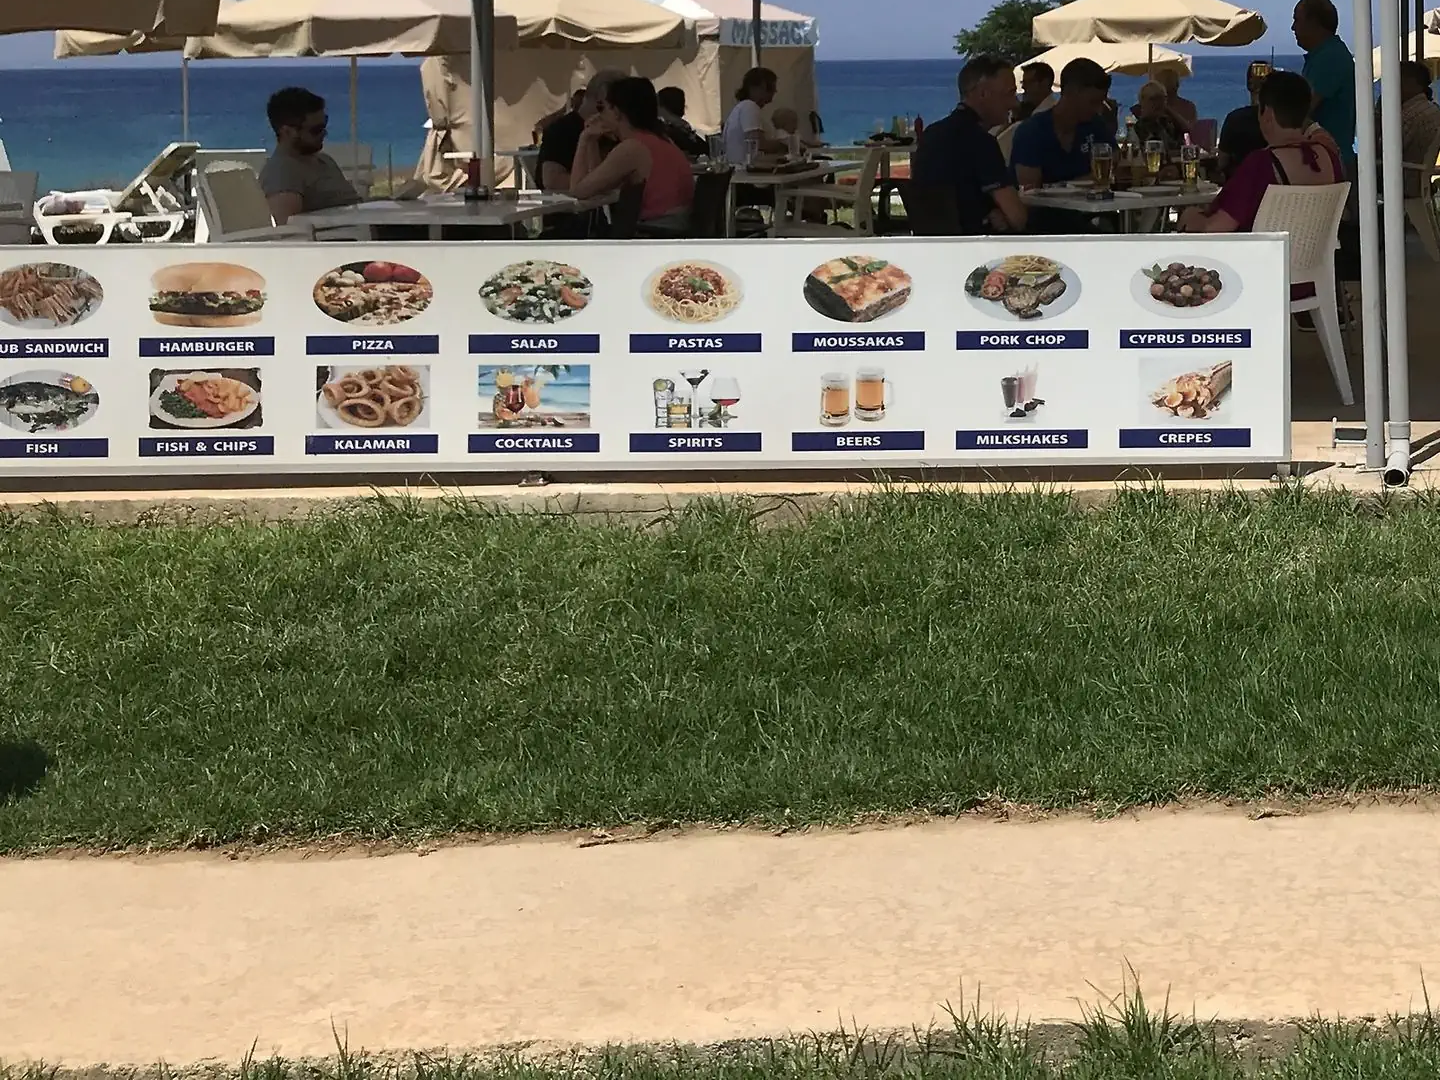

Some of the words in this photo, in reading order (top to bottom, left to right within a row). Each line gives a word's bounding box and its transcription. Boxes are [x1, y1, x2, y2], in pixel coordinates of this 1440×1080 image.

[510, 338, 559, 350] SALAD
[668, 338, 724, 349] PASTAS
[813, 336, 904, 347] MOUSSAKAS
[980, 335, 1020, 346] PORK
[1025, 334, 1066, 345] CHOP
[1129, 333, 1185, 345] CYPRUS
[1191, 333, 1243, 345] DISHES
[25, 343, 104, 354] SANDWICH
[159, 341, 255, 353] HAMBURGER
[352, 340, 395, 351] PIZZA
[494, 438, 574, 449] COCKTAILS
[668, 437, 723, 448] SPIRITS
[836, 436, 881, 447] BEERS
[976, 434, 1069, 445] MILKSHAKES
[1158, 433, 1212, 444] CREPES
[26, 443, 59, 454] FISH
[156, 441, 189, 452] FISH
[195, 441, 207, 452] &
[213, 440, 258, 452] CHIPS
[334, 439, 411, 450] KALAMARI
